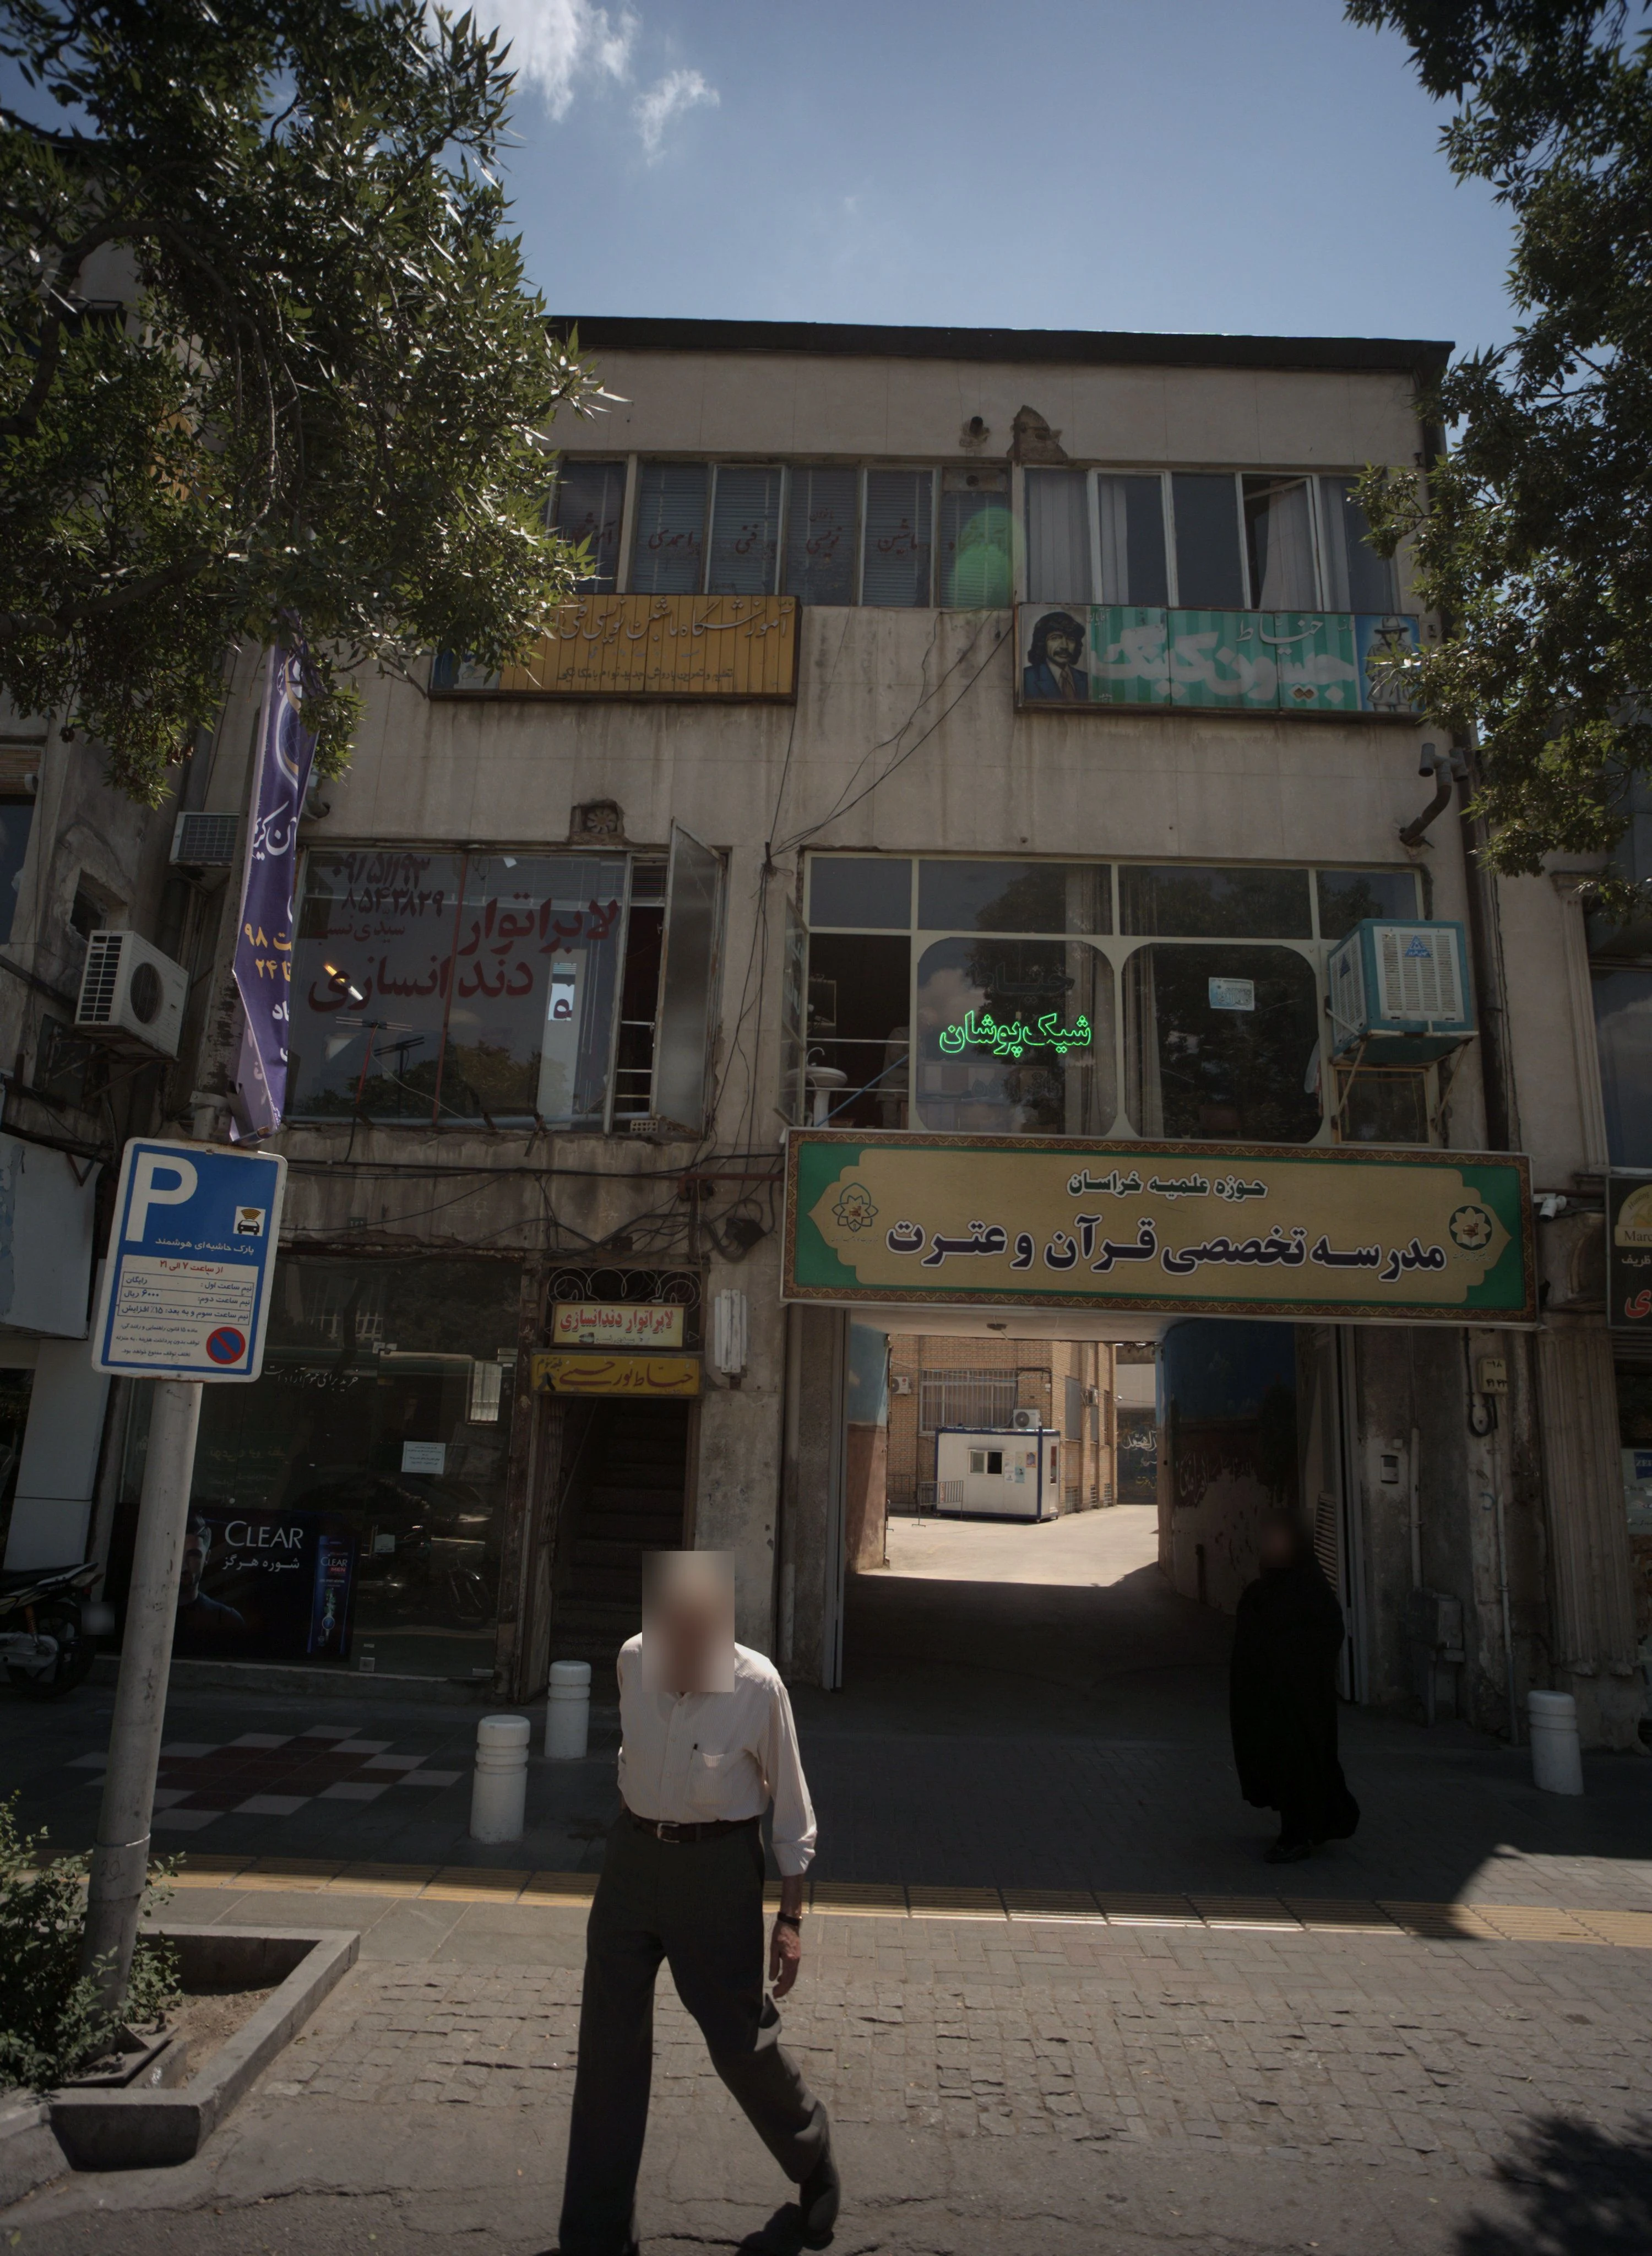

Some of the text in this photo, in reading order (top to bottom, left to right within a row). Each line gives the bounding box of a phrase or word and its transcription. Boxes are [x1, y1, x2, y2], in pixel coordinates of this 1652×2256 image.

[735, 523, 759, 554] فنی
[583, 599, 627, 643] نویسی
[626, 596, 678, 642] ماشین
[681, 596, 794, 638] آموزشگاه
[457, 892, 620, 956] لابراتوار
[307, 955, 534, 1013] دندانسازی
[938, 1009, 1093, 1058] شیک پوشان
[1067, 1168, 1268, 1200] حوزه علمیه خراسان
[126, 1152, 198, 1243] P
[1627, 1191, 1650, 1211] Hunting
[155, 1238, 193, 1250] هوشمند
[233, 1244, 254, 1256] پارک
[885, 1212, 1447, 1283] مدرسه تخصصی قرآن و عترت
[169, 1262, 180, 1271] الی
[190, 1265, 214, 1273] ساعت
[215, 1266, 224, 1275] از
[126, 1276, 148, 1285] رایگان
[124, 1290, 139, 1298] ریال
[241, 1286, 252, 1295] نیم
[122, 1304, 150, 1315] افزایش
[239, 1300, 251, 1308] نیم
[196, 1310, 213, 1320] سوم
[237, 1314, 249, 1322] نیم
[561, 1308, 673, 1335] لابراتوار دندانسازی
[285, 1366, 307, 1384] آزاد
[317, 1372, 338, 1391] برای
[339, 1369, 359, 1392] خرید
[225, 1520, 304, 1549] CLEAR
[221, 1553, 300, 1572] شوره هرگز
[320, 1557, 349, 1568] CLEAR
